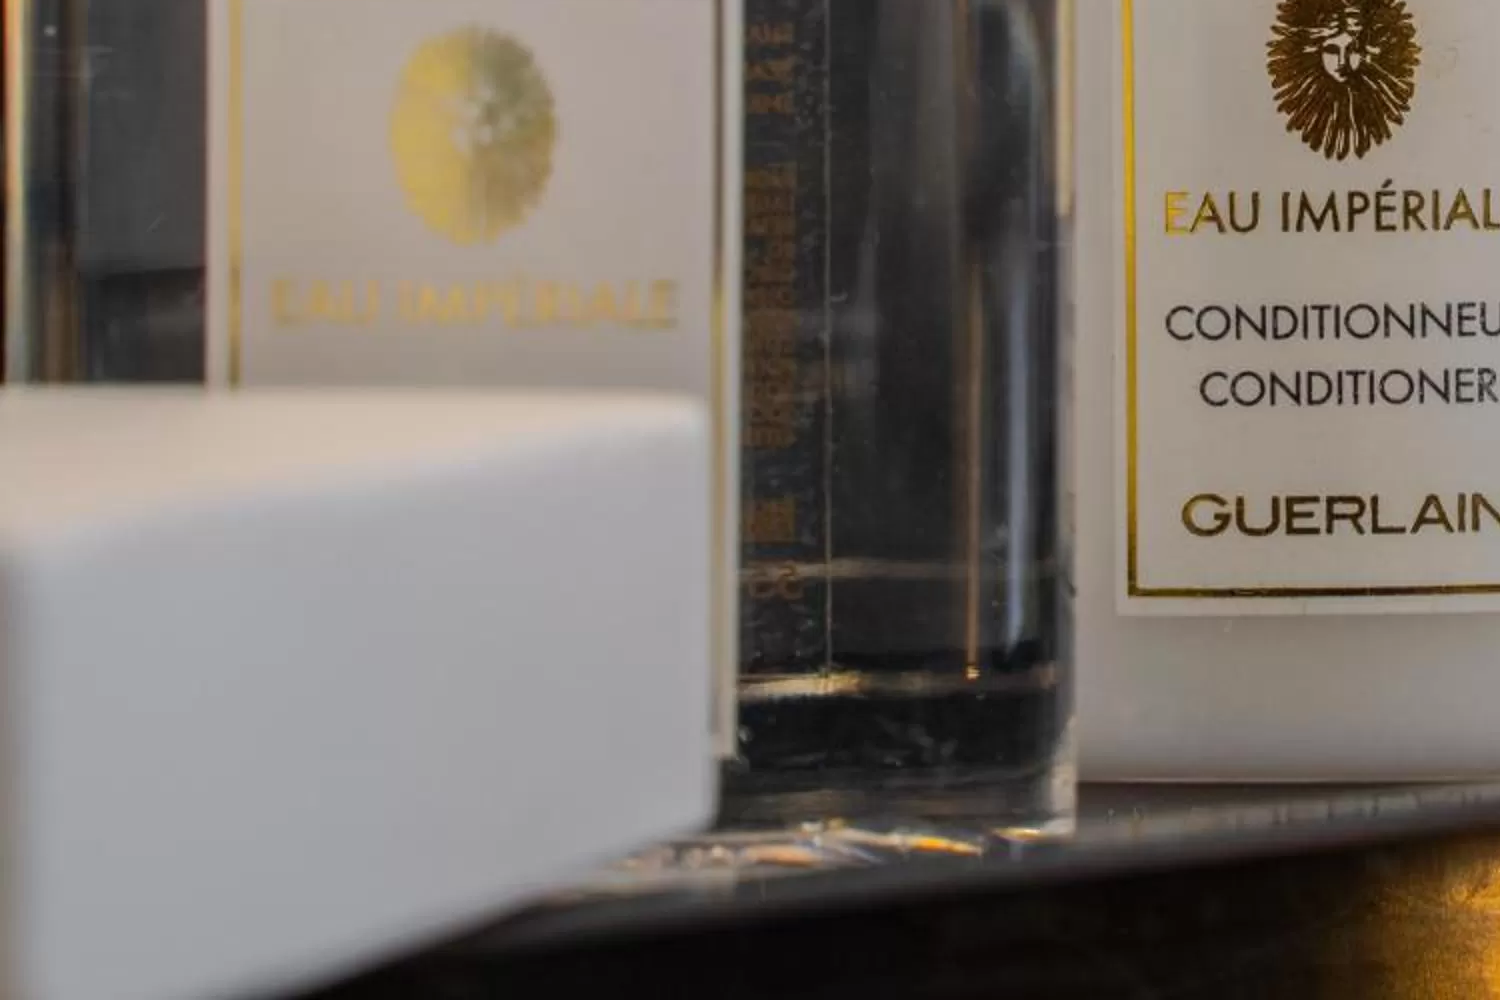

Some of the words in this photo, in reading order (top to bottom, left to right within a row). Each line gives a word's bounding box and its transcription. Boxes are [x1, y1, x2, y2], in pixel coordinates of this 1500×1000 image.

[1164, 191, 1261, 234] EAU
[270, 279, 382, 328] EAU
[396, 268, 681, 329] IMPÉRIALE
[1199, 368, 1500, 407] CONDITIONER
